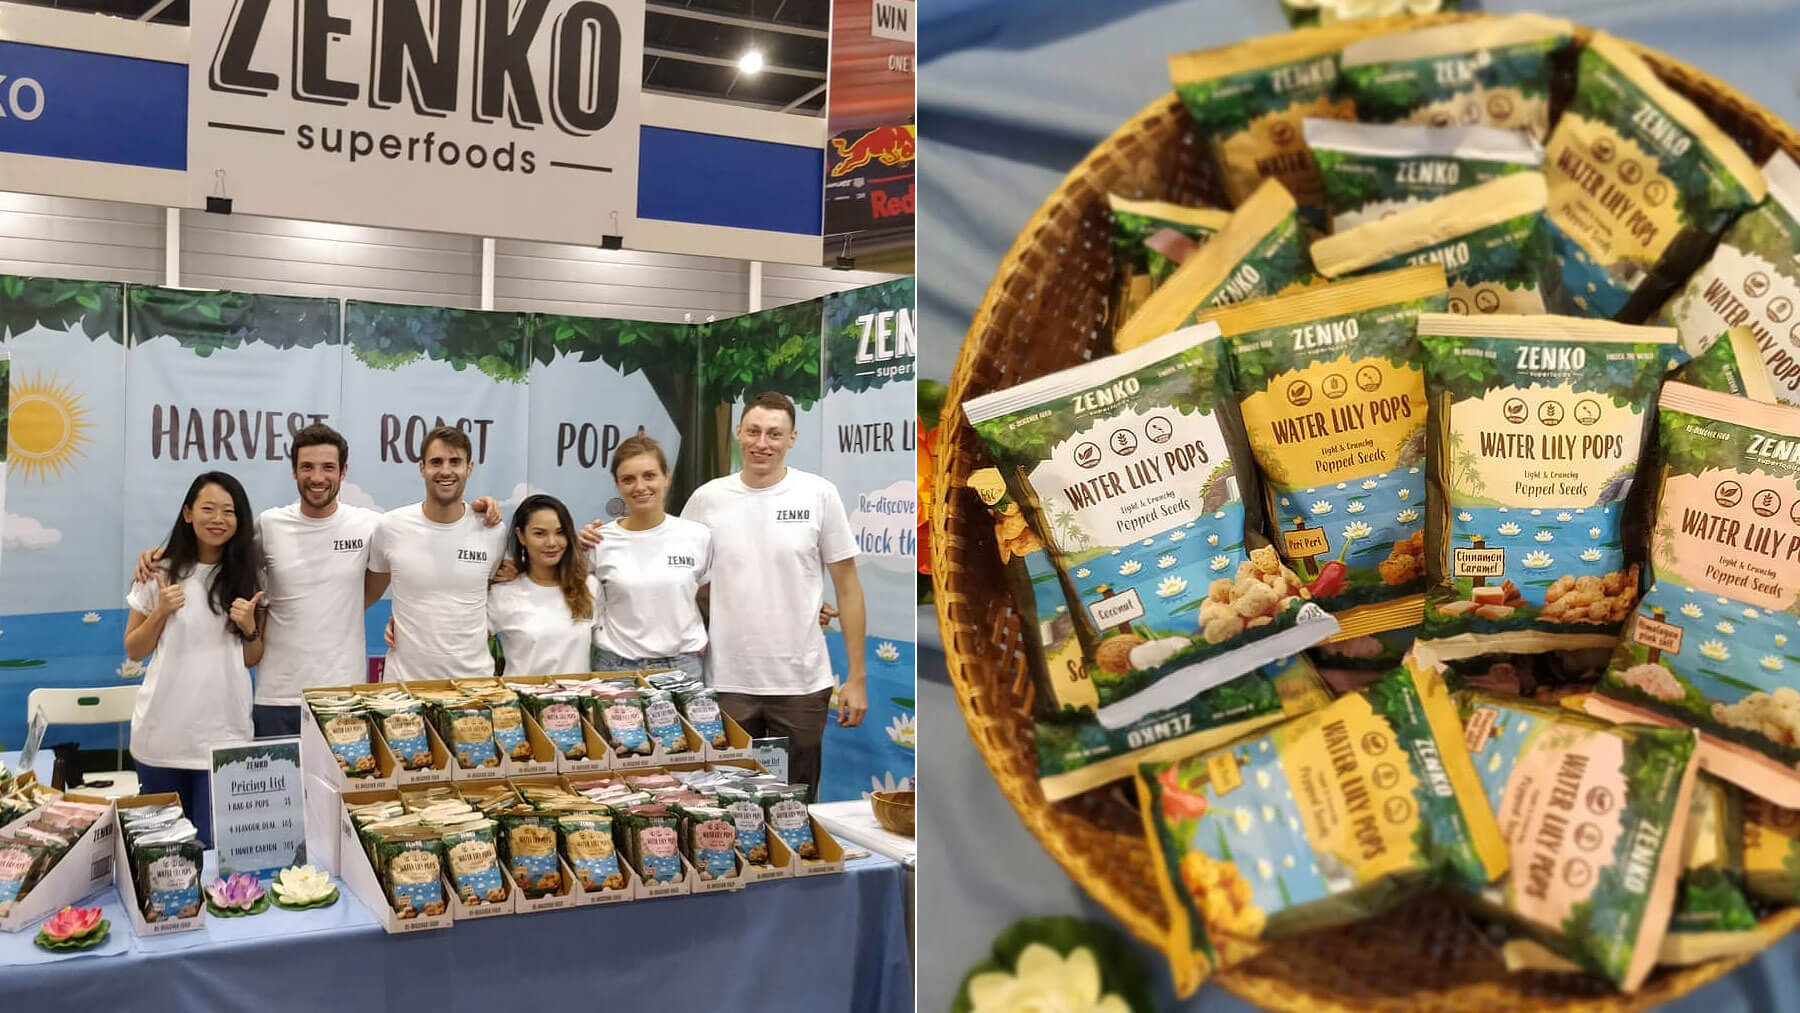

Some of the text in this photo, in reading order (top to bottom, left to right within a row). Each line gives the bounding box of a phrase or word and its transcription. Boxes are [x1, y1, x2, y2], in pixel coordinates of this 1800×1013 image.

[876, 3, 908, 32] WIN
[208, 0, 622, 137] ZENKO
[1632, 103, 1692, 157] ZENKO
[297, 123, 536, 174] superfoods
[1396, 161, 1460, 185] ZENKO
[1557, 147, 1659, 247] WATER LILY POPS
[1703, 277, 1751, 328] WATER
[1292, 318, 1359, 351] ZENKO
[1516, 345, 1586, 370] ZENKO
[1072, 376, 1141, 416] ZENKO
[1271, 393, 1412, 445] WATER LILY POPS
[557, 423, 620, 469] POP
[838, 422, 895, 454] WATER
[1480, 431, 1623, 461] WATER LILY POPS
[1063, 440, 1209, 512] WATER LILY POPS
[1315, 449, 1387, 474] Popped Seeds
[1524, 469, 1541, 480] Light
[1550, 469, 1579, 480] Crunchy
[1515, 479, 1588, 498] Popped Seeds
[776, 509, 810, 521] ZENKO
[1116, 498, 1192, 534] Popped Seeds
[1120, 500, 1139, 516] Light
[334, 539, 364, 551] ZENKO
[855, 527, 893, 554] lock
[1681, 506, 1741, 547] WATER
[1744, 523, 1786, 559] LILY
[457, 549, 488, 562] ZENKO
[667, 555, 695, 568] ZENKO
[1456, 551, 1502, 563] Cinnamon
[1461, 562, 1498, 573] Caramel
[1719, 555, 1737, 568] Light
[1705, 563, 1784, 599] Popped Seeds
[1097, 599, 1134, 620] Coconut
[231, 776, 286, 793] Pricing List
[1321, 718, 1388, 862] WATER LILY POPS
[1549, 752, 1590, 813] WATER
[1535, 811, 1568, 853] LILY
